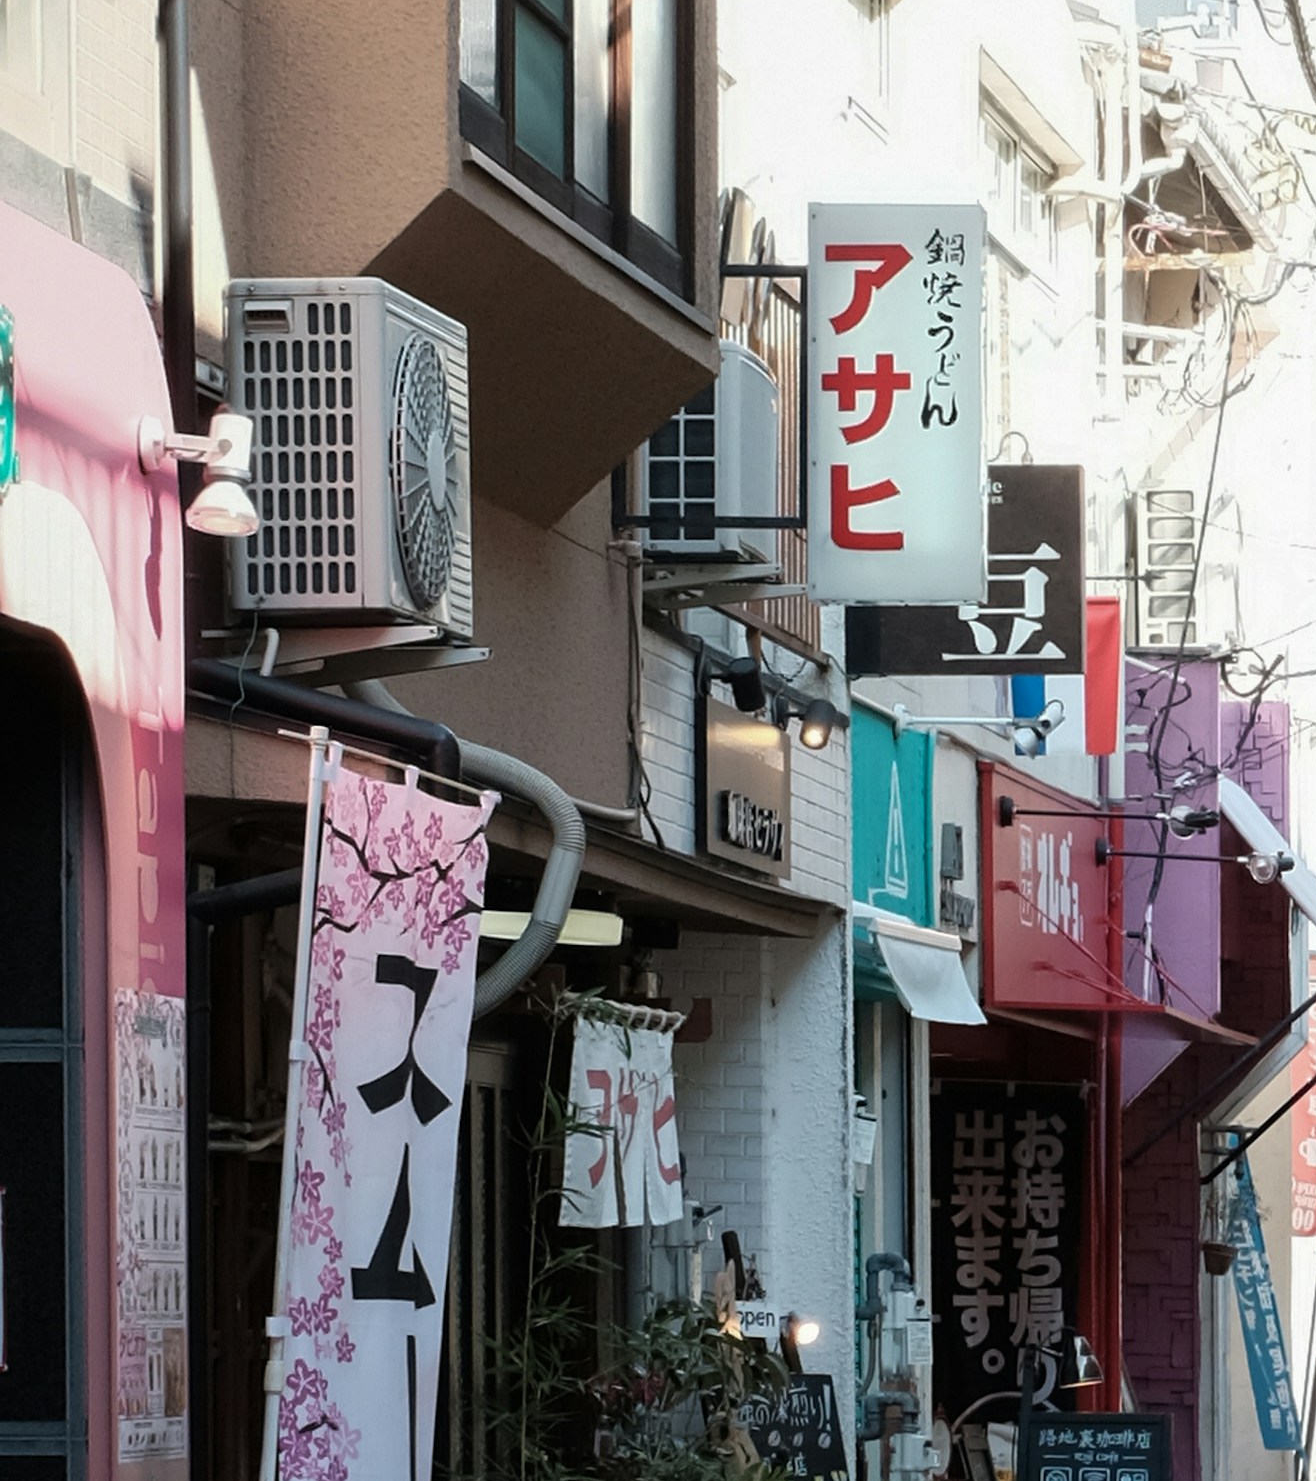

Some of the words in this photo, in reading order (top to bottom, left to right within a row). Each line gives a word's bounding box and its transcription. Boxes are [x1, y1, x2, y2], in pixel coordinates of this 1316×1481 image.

[822, 242, 914, 553] アサヒ
[920, 227, 967, 430] 鍋焼うどん
[950, 1109, 1006, 1375] 出来ます。
[1008, 1109, 1069, 1406] お持ち帰り
